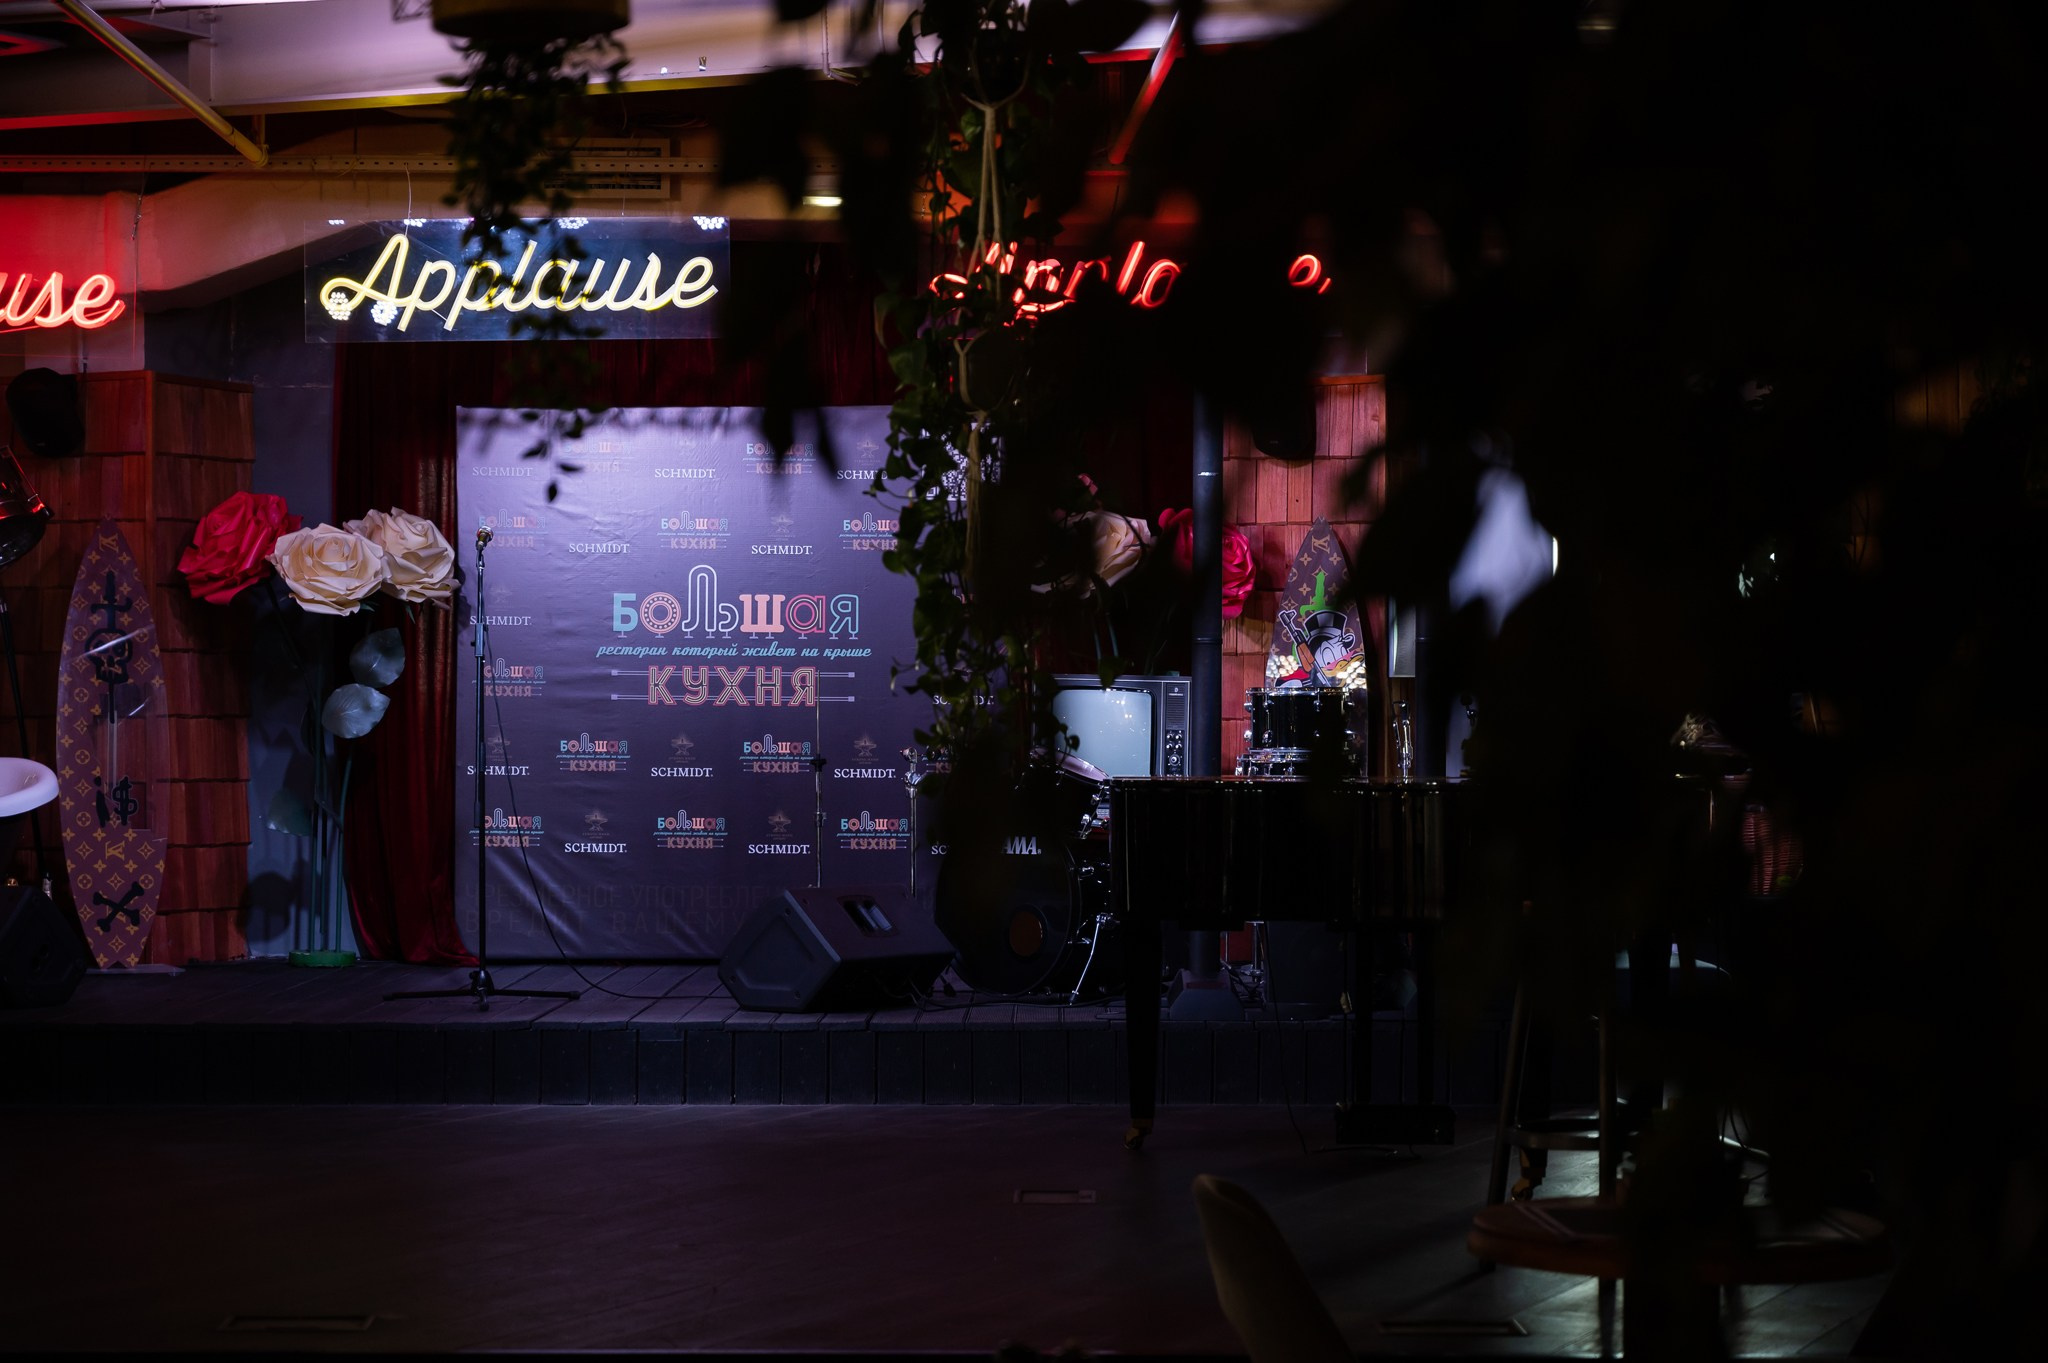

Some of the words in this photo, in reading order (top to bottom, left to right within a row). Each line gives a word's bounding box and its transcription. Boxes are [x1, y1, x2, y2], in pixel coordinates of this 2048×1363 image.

[320, 233, 719, 332] Applause
[469, 615, 532, 626] SHMIDT.
[596, 645, 667, 659] ресторан
[672, 643, 739, 659] который
[741, 640, 797, 658] живет
[801, 647, 820, 657] на
[823, 646, 872, 660] крыше
[647, 665, 817, 707] КУХНЯ
